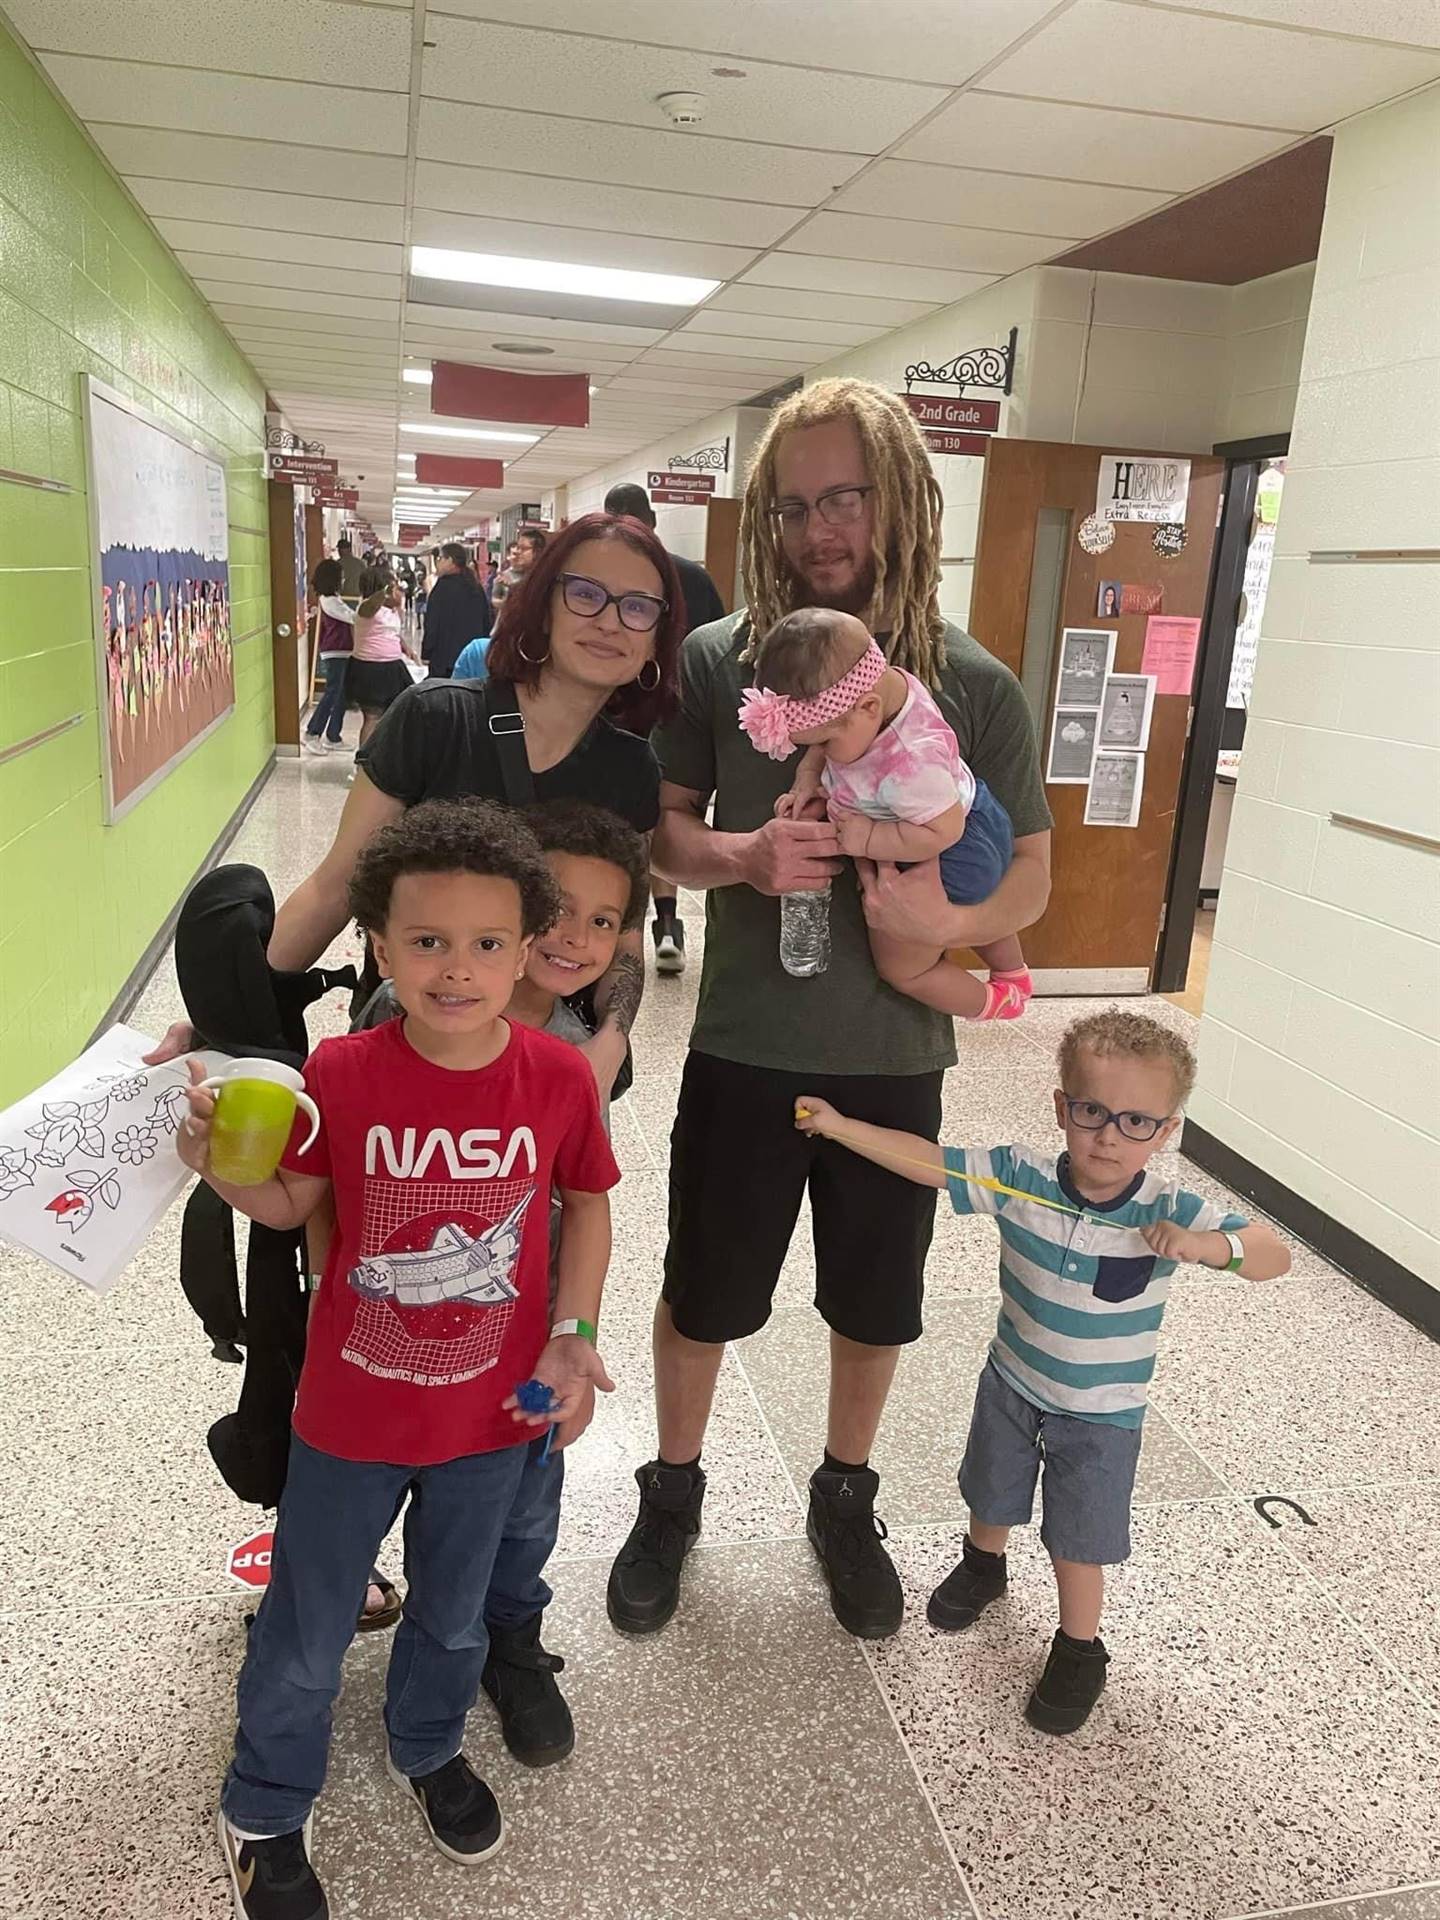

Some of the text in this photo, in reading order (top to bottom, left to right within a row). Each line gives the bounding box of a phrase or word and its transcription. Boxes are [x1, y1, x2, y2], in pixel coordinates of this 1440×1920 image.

[919, 403, 980, 423] 2nd Grade
[944, 437, 960, 449] 130
[287, 459, 332, 471] Intervention
[665, 477, 710, 489] Kindergarten
[1111, 462, 1178, 502] HERE
[1104, 507, 1129, 520] Extra
[1166, 526, 1182, 537] STAY
[365, 1125, 537, 1179] NASA
[341, 1347, 370, 1370] NATIONAL
[367, 1361, 413, 1382] AERONAUTICS
[412, 1372, 427, 1386] AND
[427, 1375, 451, 1386] SPACE
